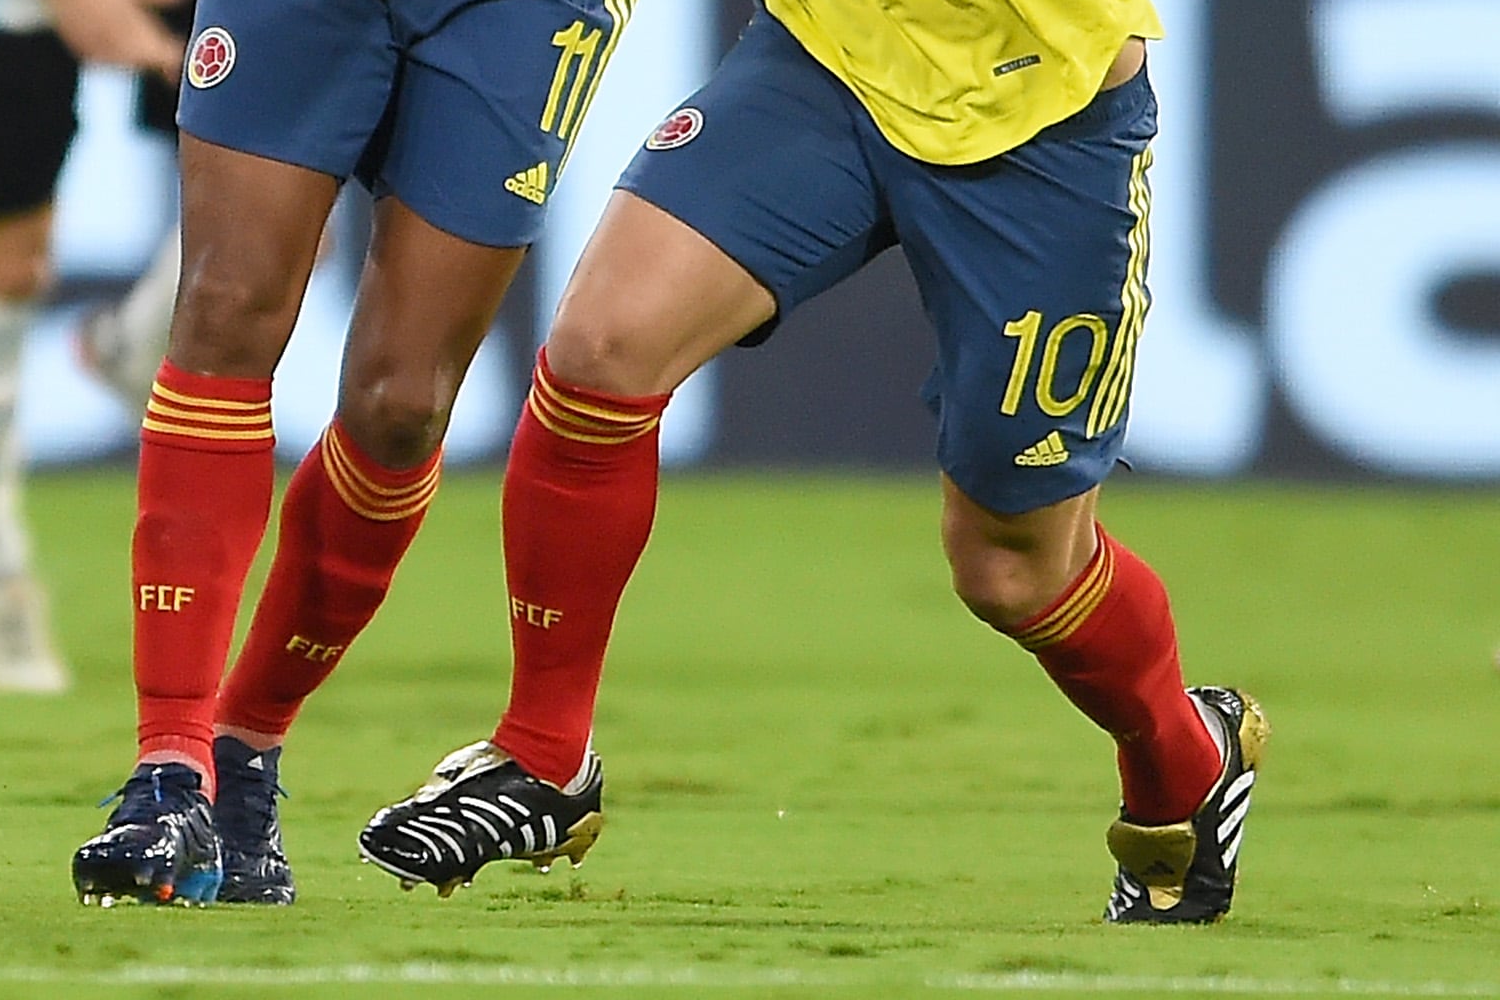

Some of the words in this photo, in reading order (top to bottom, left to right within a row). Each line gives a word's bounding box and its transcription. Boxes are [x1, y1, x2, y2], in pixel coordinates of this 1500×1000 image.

[539, 20, 602, 140] 11
[1000, 310, 1108, 417] 10
[1014, 450, 1069, 467] adidas
[139, 584, 195, 611] FCF
[511, 596, 564, 630] FCF
[285, 634, 343, 662] FCF
